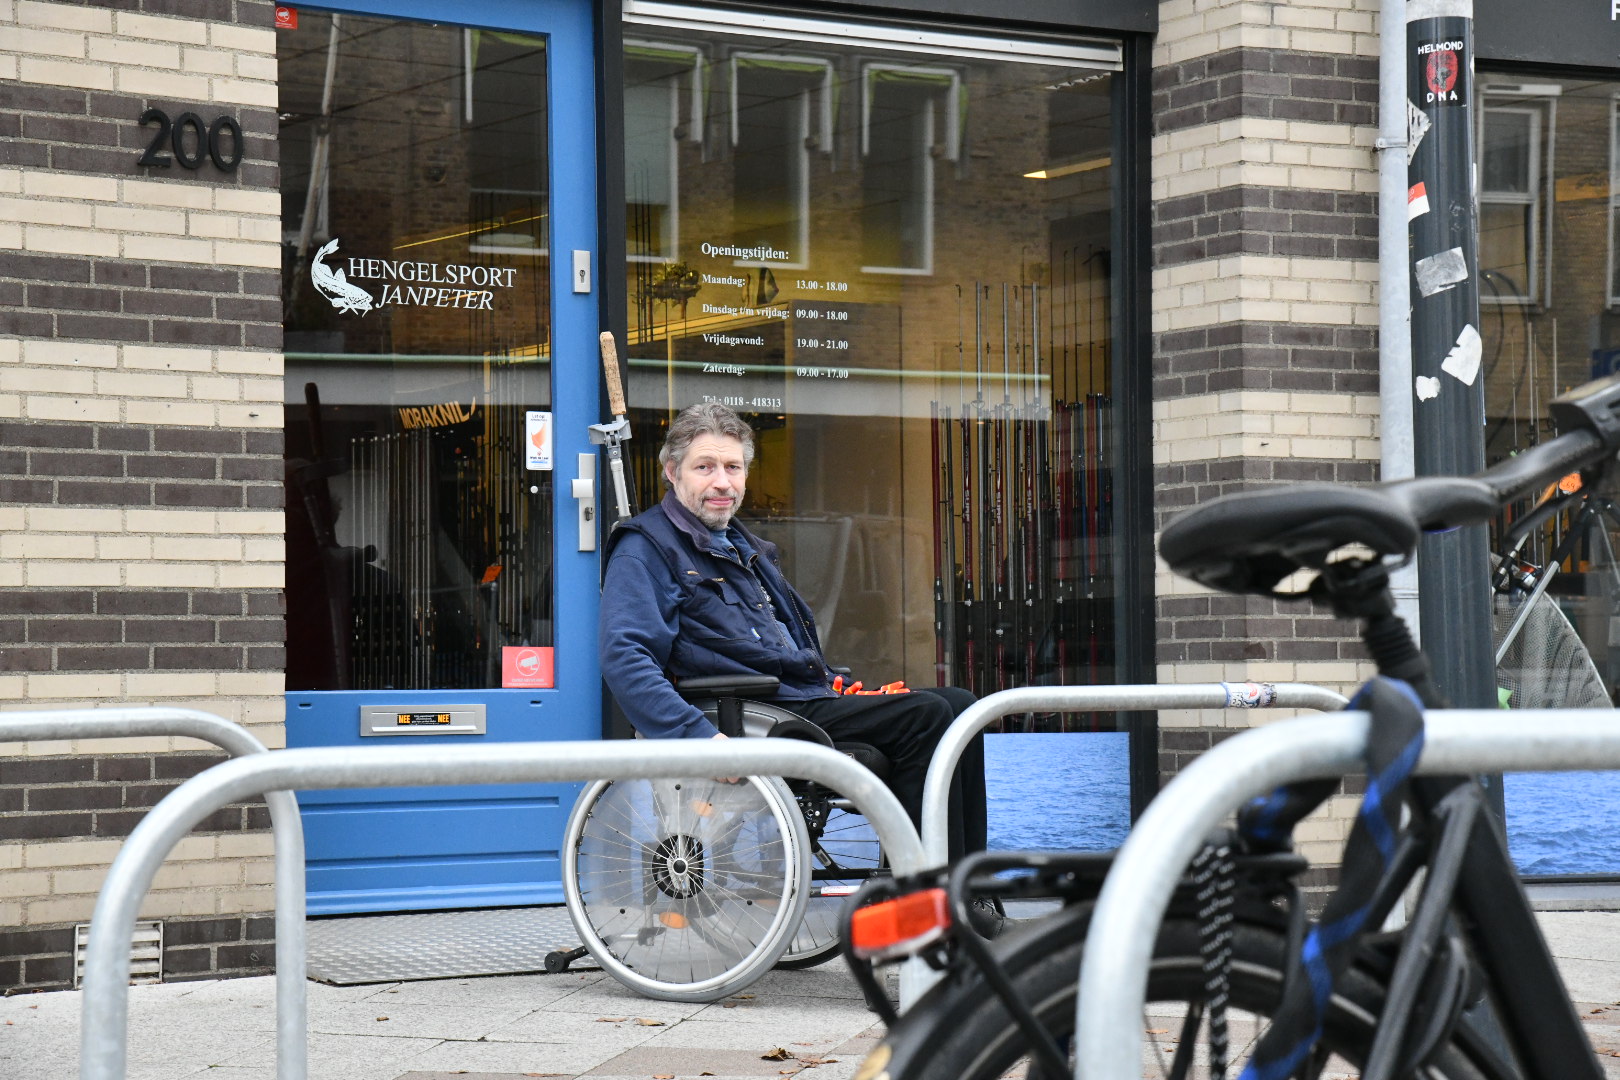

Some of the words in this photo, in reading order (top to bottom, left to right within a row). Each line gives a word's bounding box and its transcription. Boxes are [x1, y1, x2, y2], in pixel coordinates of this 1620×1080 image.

[1417, 41, 1464, 55] HELMOND
[138, 108, 244, 173] 200
[701, 243, 790, 260] Openingstijden:
[347, 257, 517, 289] HENGELSPORT
[702, 274, 746, 288] Maandag:
[796, 280, 818, 290] 13.00
[826, 282, 848, 292] 18.00
[375, 284, 494, 312] JANPETER
[702, 304, 737, 316] Dinsdag
[739, 307, 754, 316] t/m
[757, 308, 790, 319] vrijdag:
[796, 309, 818, 319] 09.00
[826, 311, 848, 321] 18.00
[703, 334, 764, 347] Vrijdagavond:
[797, 338, 819, 349] 19.00
[826, 340, 848, 350] 21.00
[703, 363, 746, 377] Zaterdag:
[797, 368, 819, 378] 09.00
[826, 369, 849, 379] 17.00
[724, 396, 744, 406] 0118
[752, 397, 781, 408] 418313
[398, 715, 411, 724] NEE
[437, 714, 450, 723] NEE
